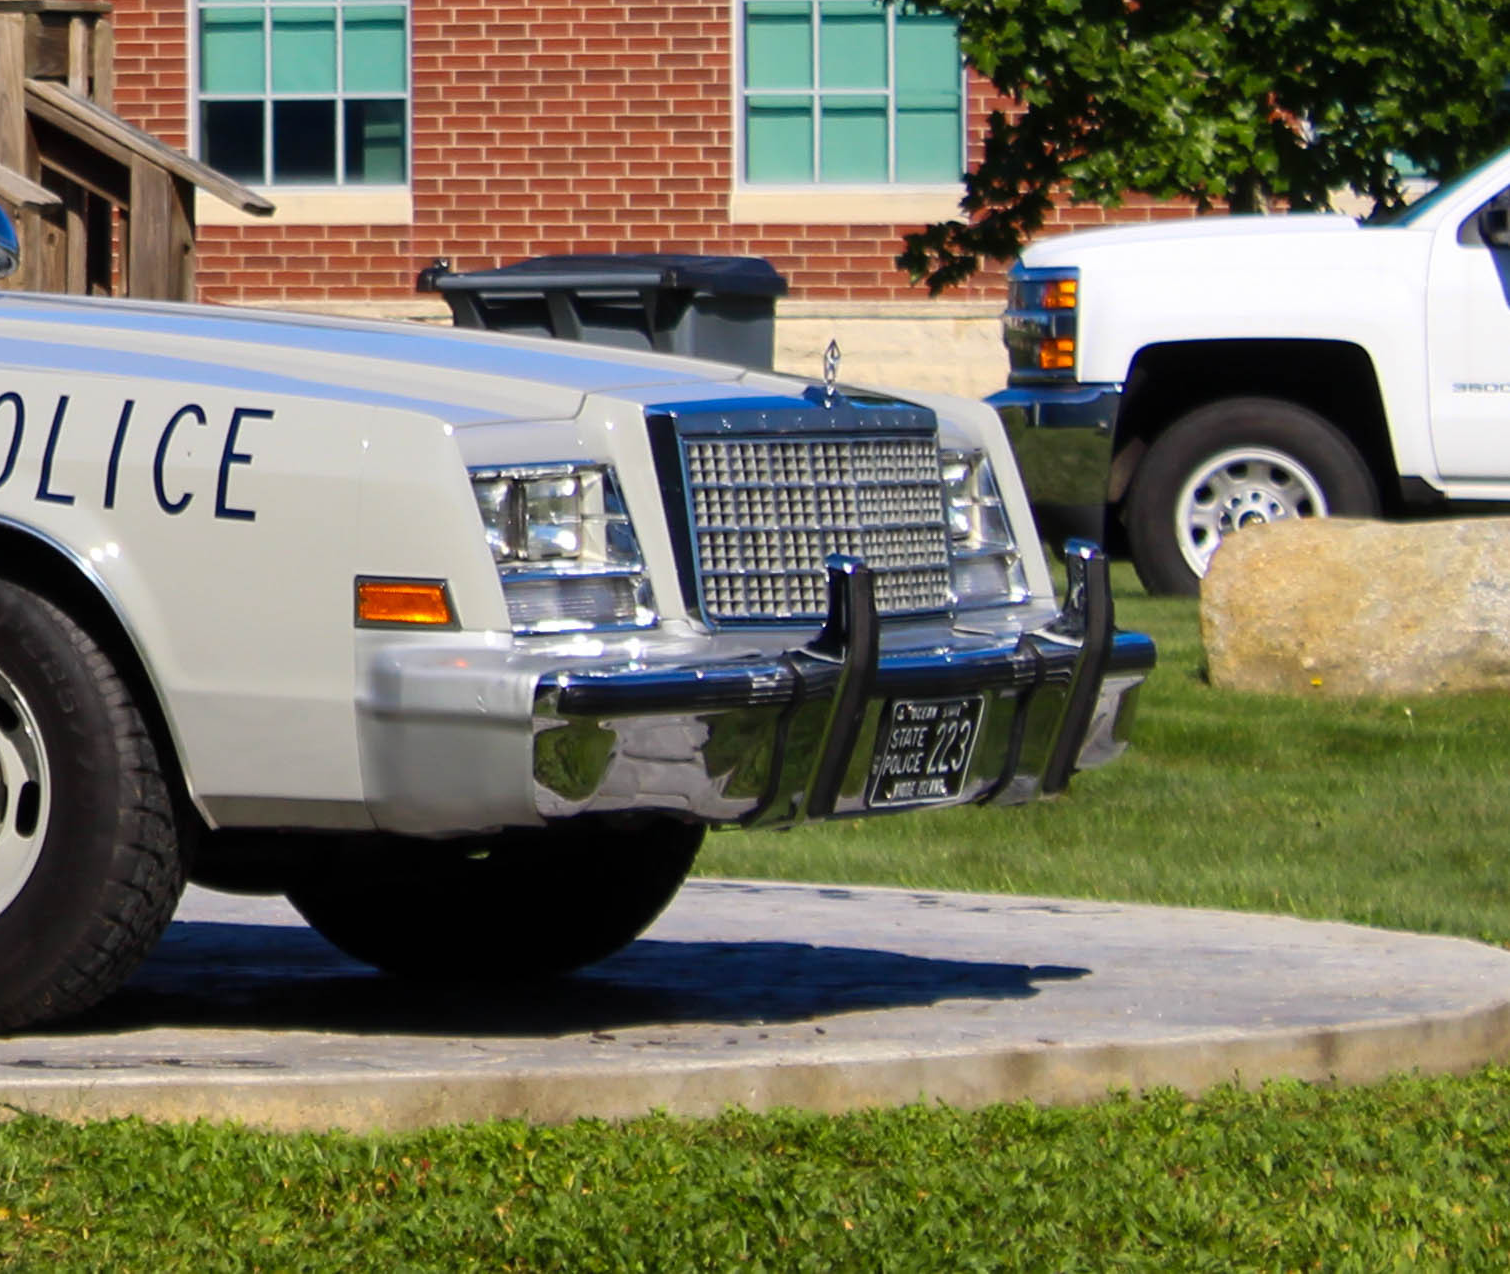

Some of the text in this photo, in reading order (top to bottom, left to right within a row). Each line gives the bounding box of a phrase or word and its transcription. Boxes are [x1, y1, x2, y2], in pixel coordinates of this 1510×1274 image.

[890, 727, 928, 749] STATE
[926, 720, 972, 774] 223
[883, 752, 924, 775] POLICE
